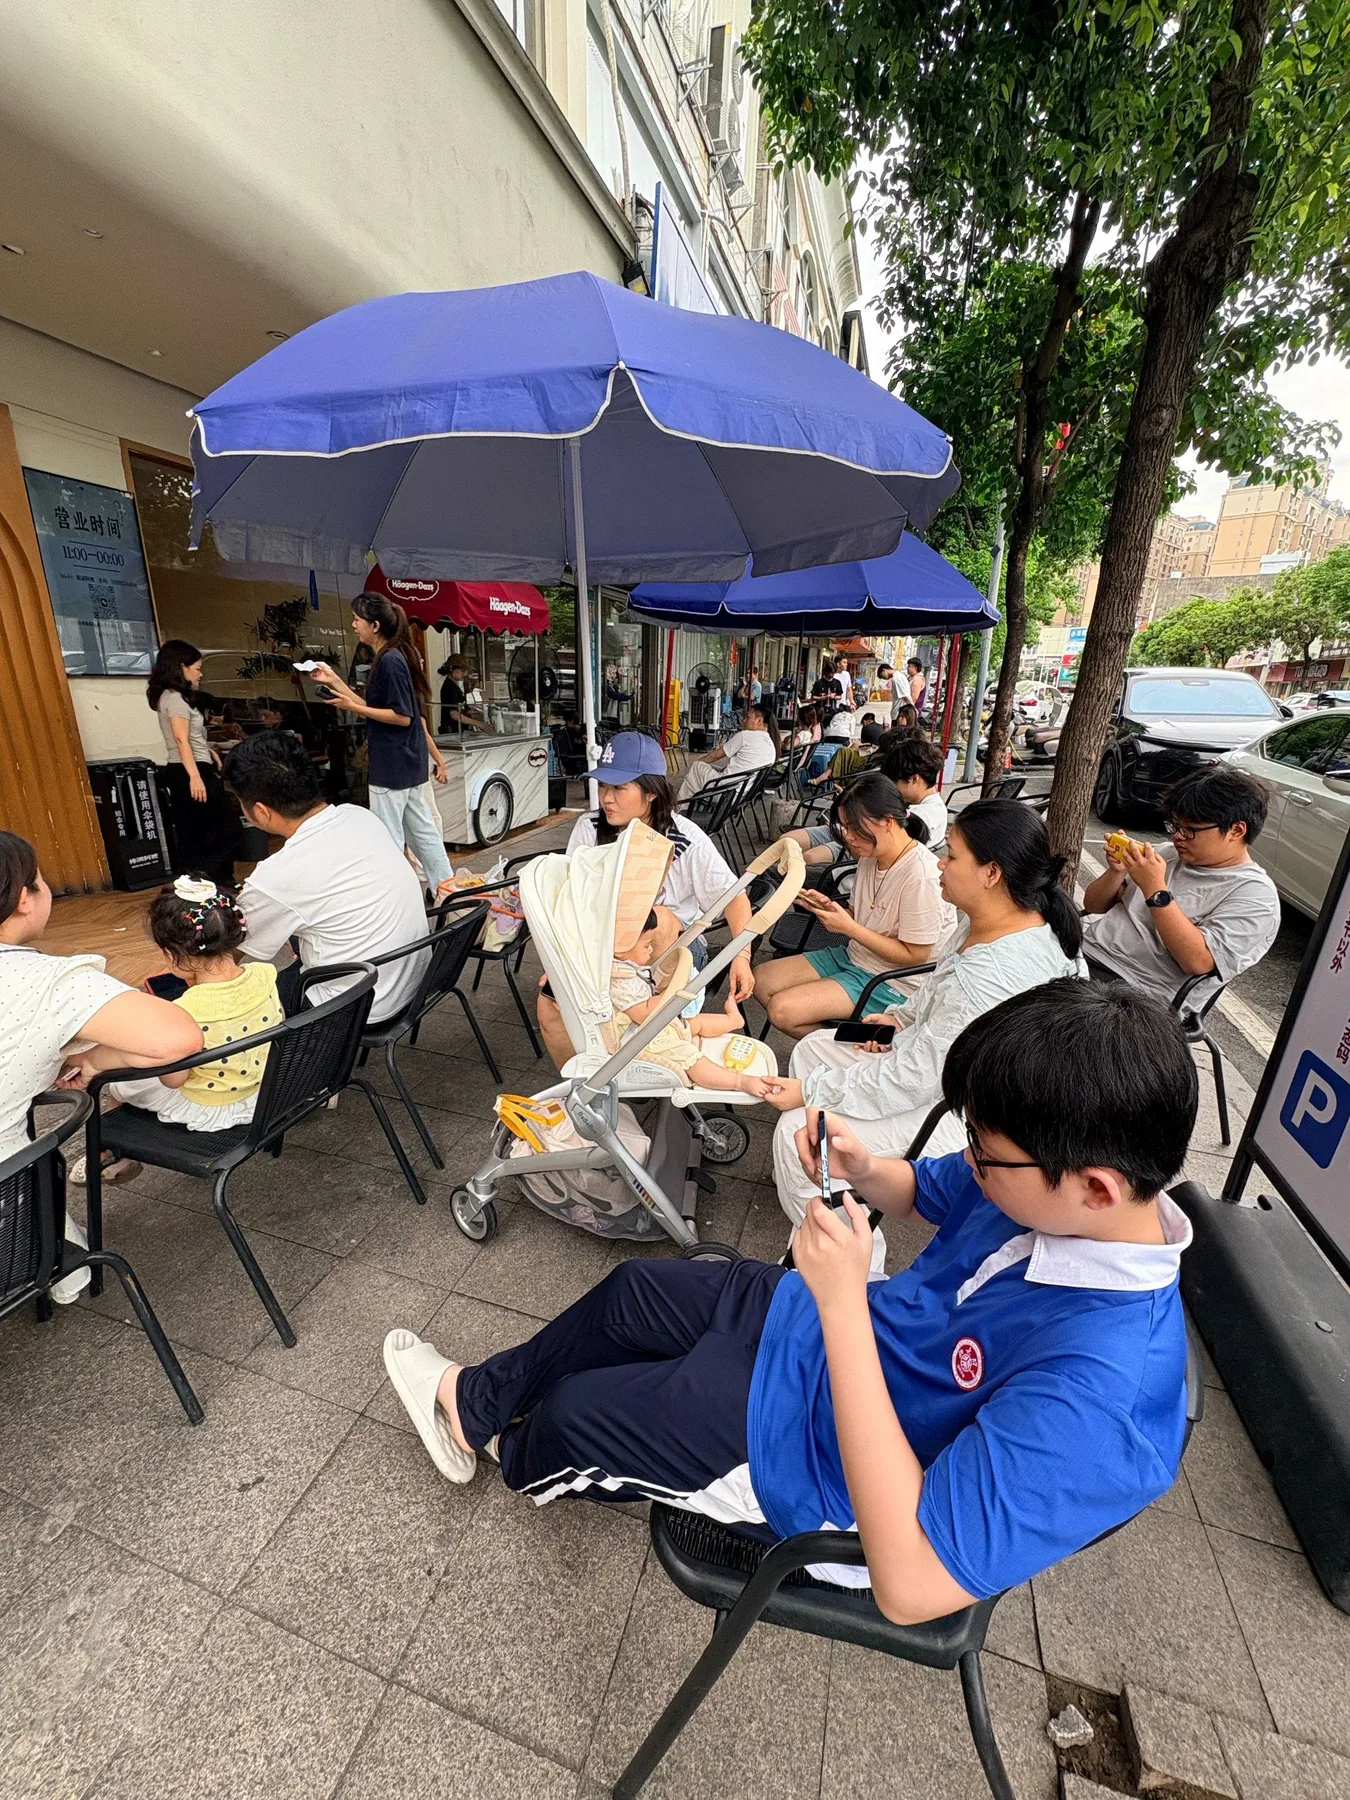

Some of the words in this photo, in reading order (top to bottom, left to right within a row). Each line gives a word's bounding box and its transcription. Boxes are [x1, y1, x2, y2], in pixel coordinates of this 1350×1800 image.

[55, 505, 121, 539] 营业时间
[391, 578, 434, 592] Häagen-Dazs
[489, 596, 531, 619] Häagen-Dazs
[136, 780, 158, 840] 请使用伞袋机
[1291, 1069, 1337, 1128] P
